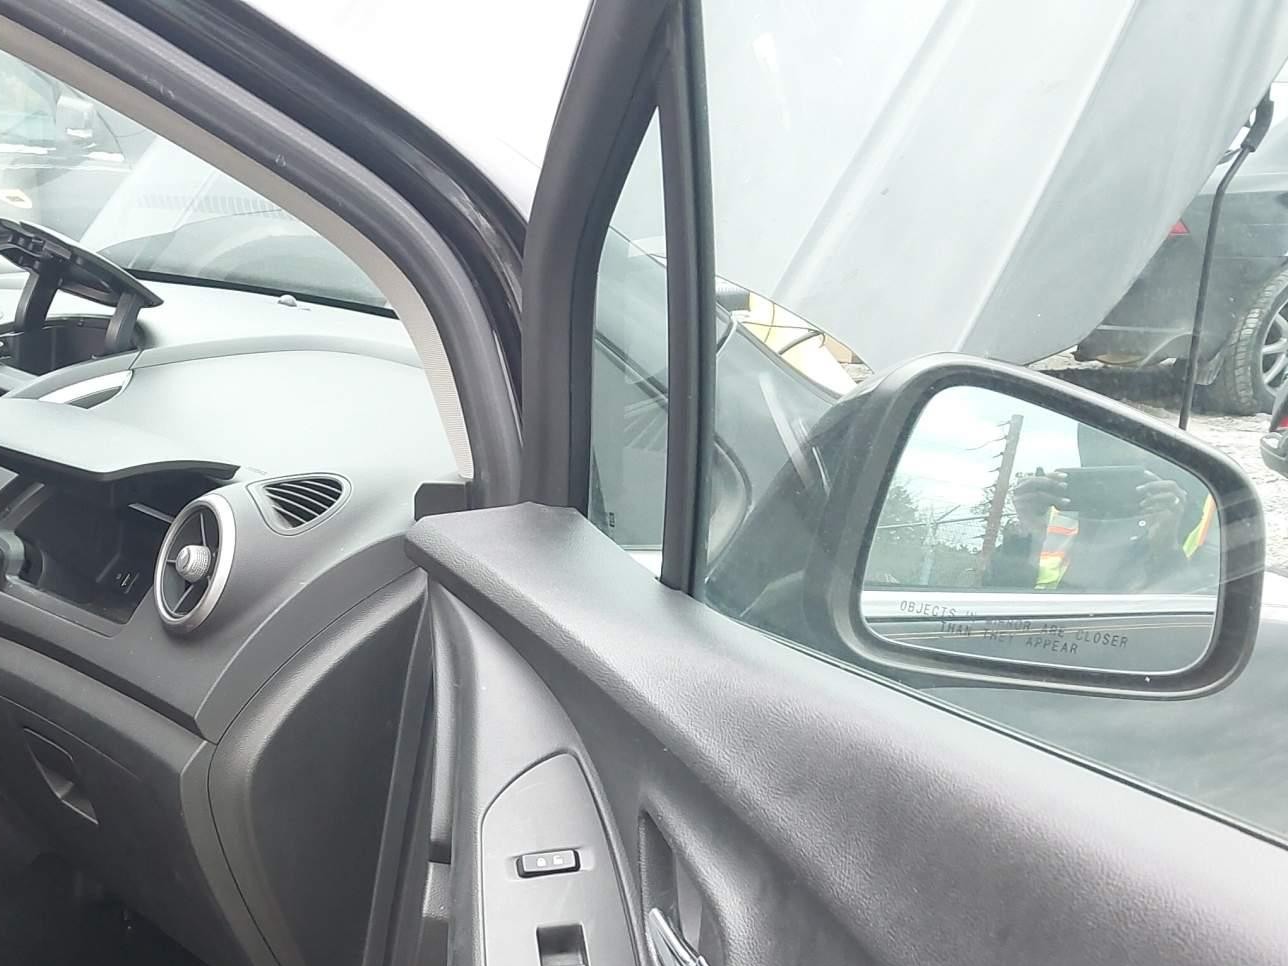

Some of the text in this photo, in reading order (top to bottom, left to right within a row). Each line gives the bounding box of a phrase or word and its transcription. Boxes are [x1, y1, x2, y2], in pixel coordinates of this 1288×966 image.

[899, 599, 957, 618] OBJECTS
[1075, 629, 1129, 649] CLOSER
[1025, 636, 1079, 655] APPEAR
